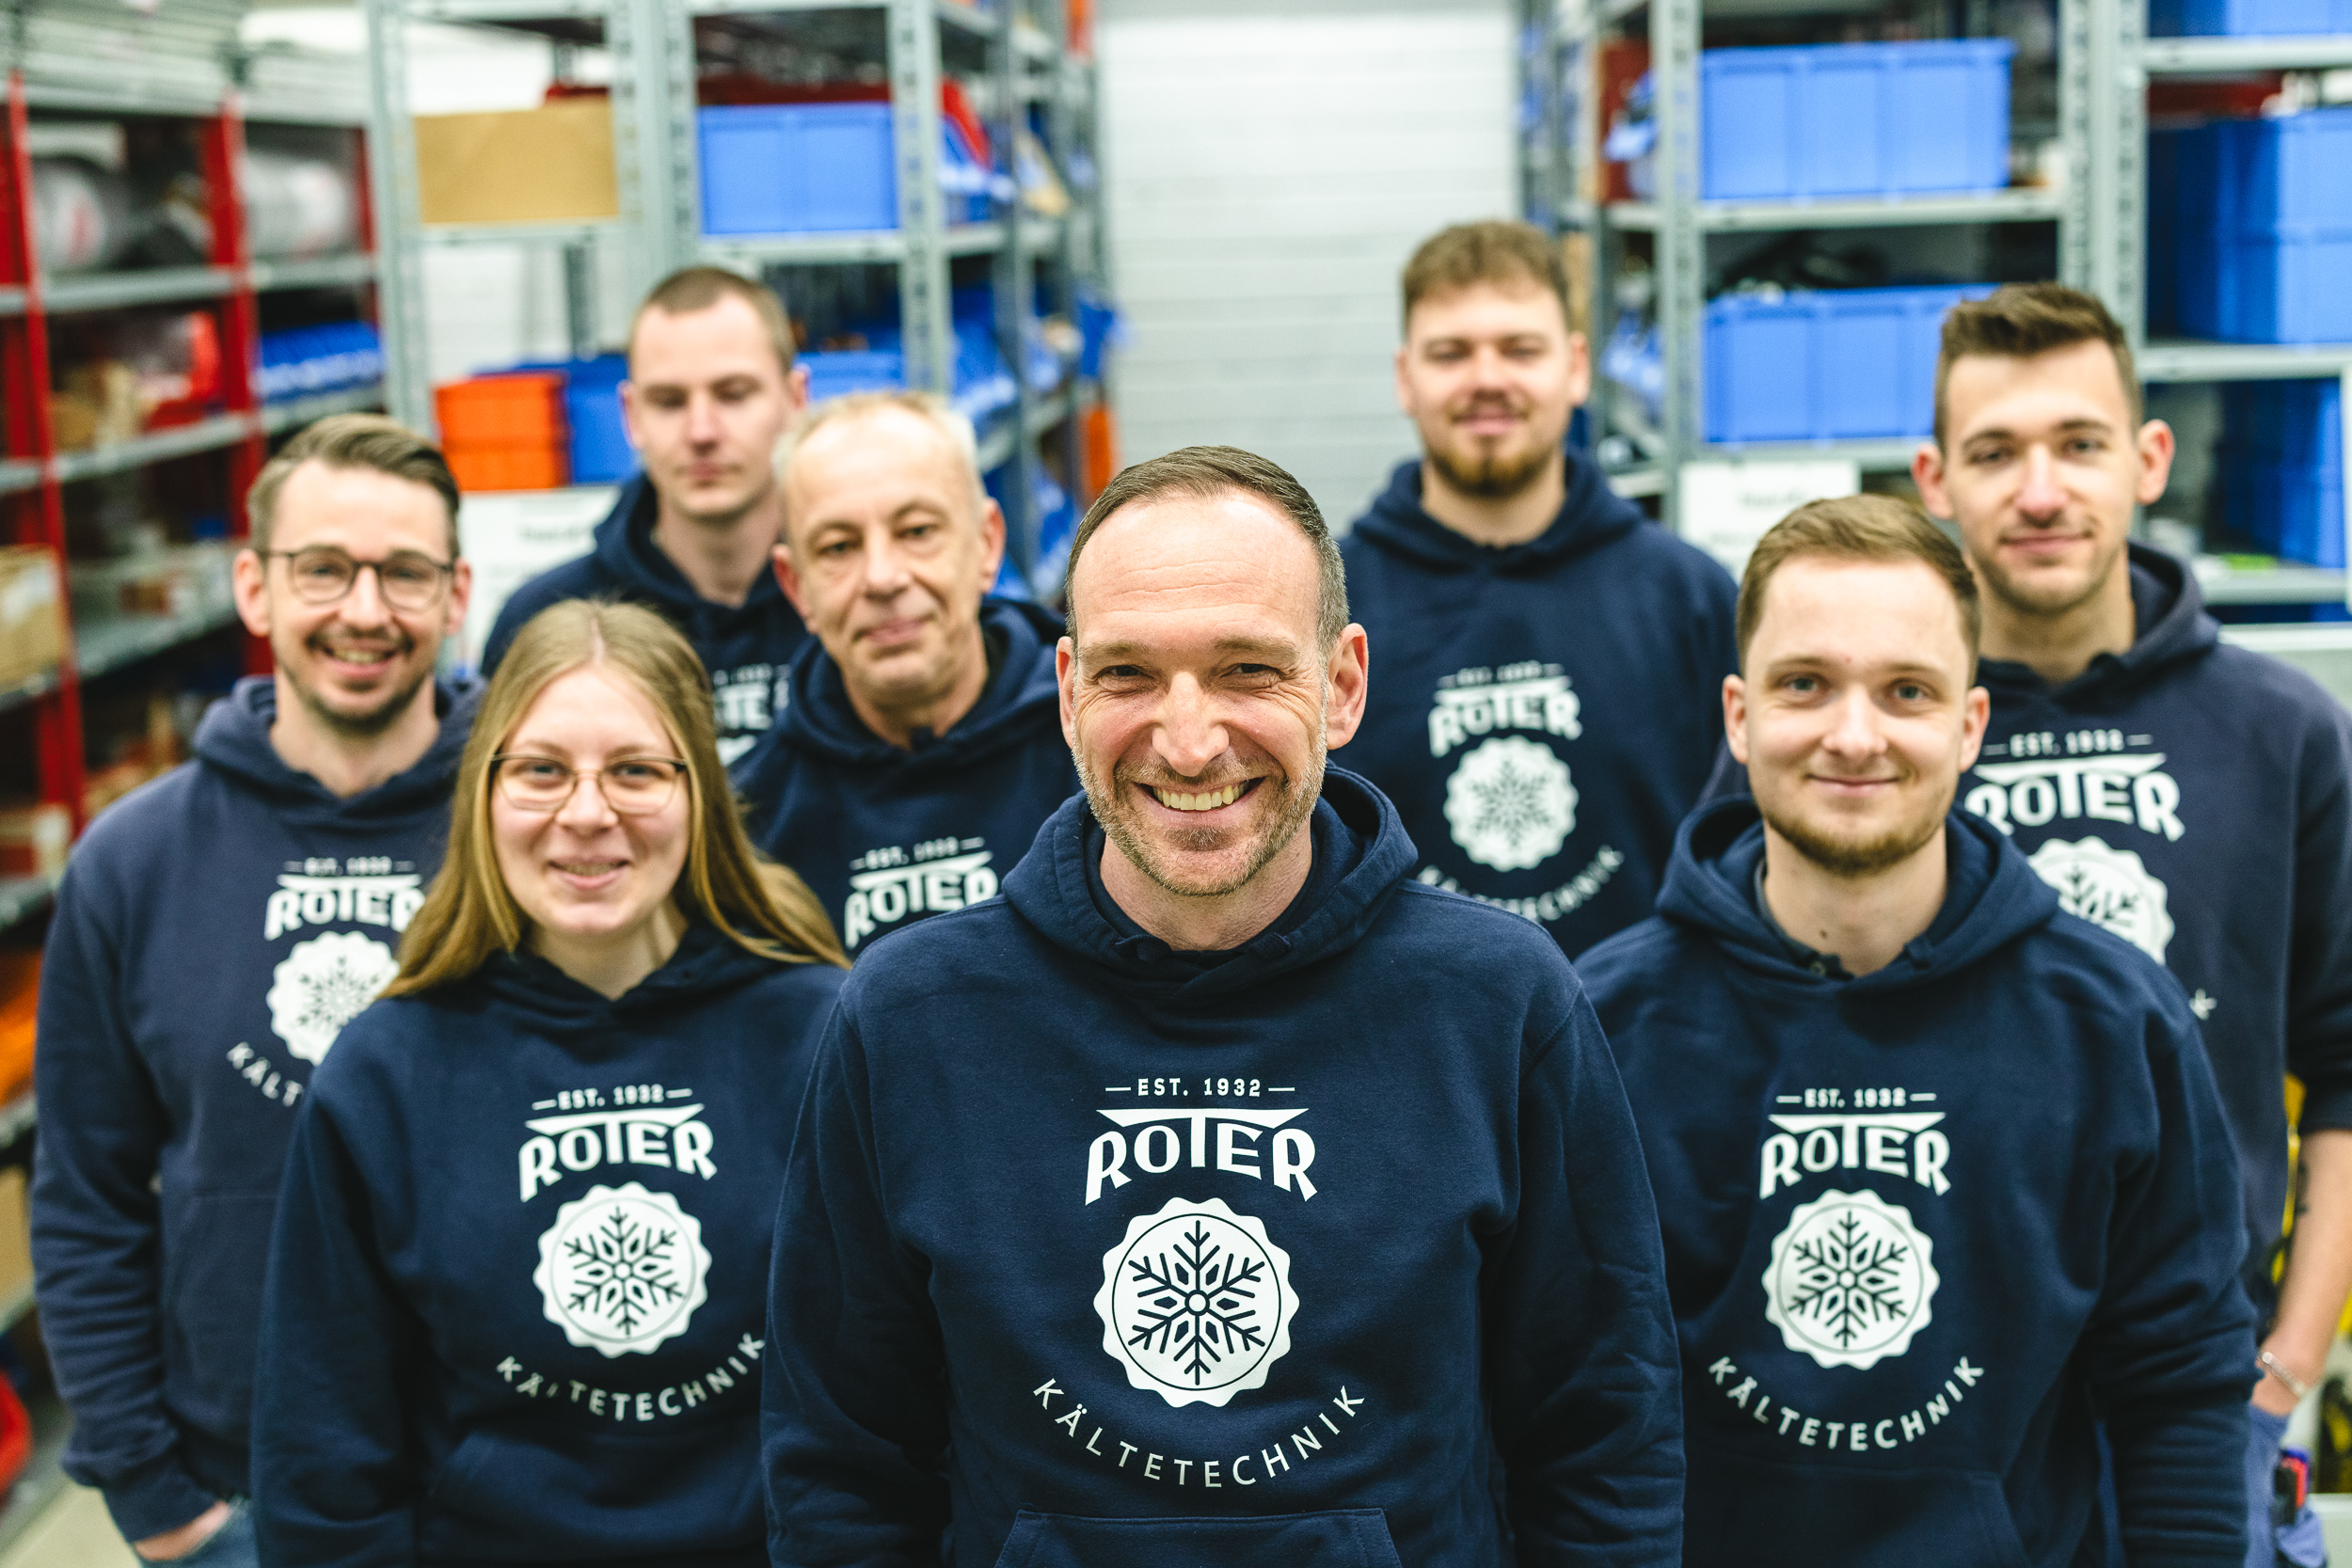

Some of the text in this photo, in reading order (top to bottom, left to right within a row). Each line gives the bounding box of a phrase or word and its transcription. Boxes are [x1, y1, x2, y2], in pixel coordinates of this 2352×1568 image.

[1963, 752, 2186, 842] ROTER
[262, 874, 425, 941] ROTER
[843, 850, 998, 949] ROTER
[558, 1084, 665, 1110] EST. 1932
[1137, 1078, 1262, 1098] EST. 1932
[1804, 1086, 1907, 1108] EST. 1932
[517, 1102, 718, 1203] ROTER
[1085, 1108, 1318, 1206] ROTER
[1759, 1112, 1951, 1200] ROTER
[1033, 1378, 1365, 1488] KÄLTETECHNIK
[1708, 1356, 1984, 1451] KÄLTETECHNIK
